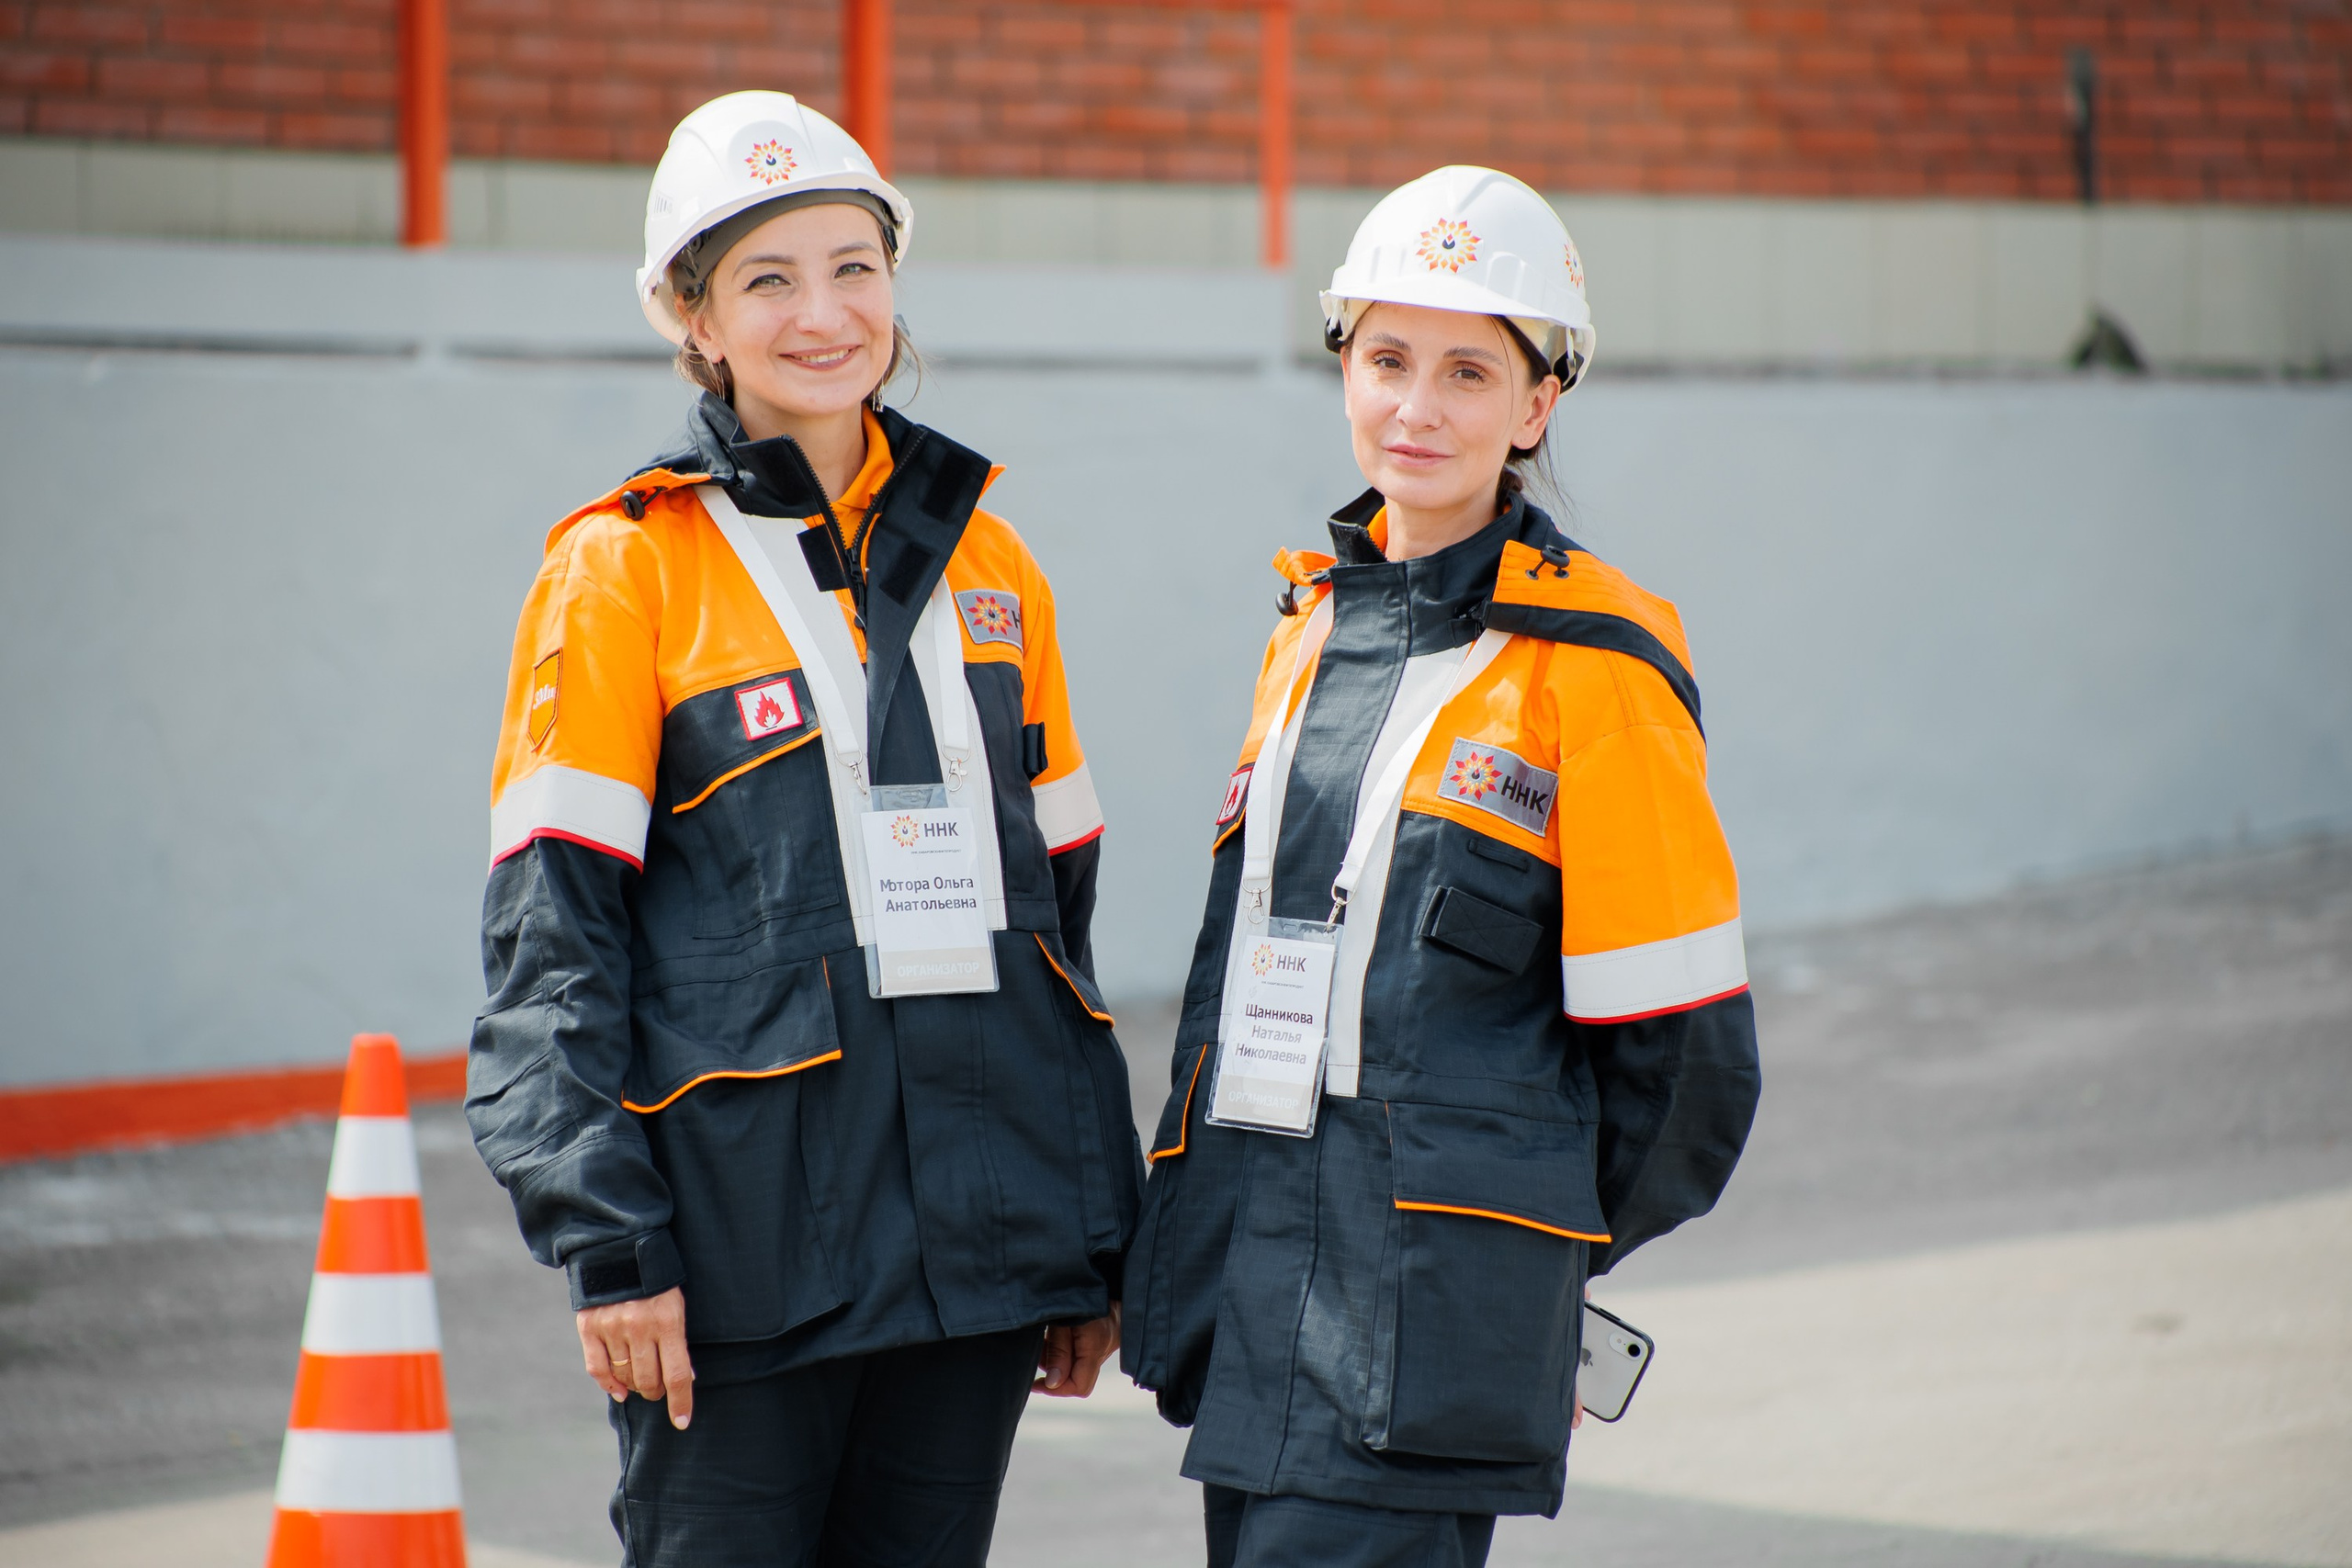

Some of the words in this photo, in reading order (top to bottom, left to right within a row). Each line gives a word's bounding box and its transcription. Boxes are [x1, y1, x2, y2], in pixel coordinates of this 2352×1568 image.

[1501, 775, 1549, 815] ННК
[923, 821, 959, 837] ННК
[880, 878, 930, 894] Мотора
[933, 876, 974, 890] Ольга
[886, 897, 978, 913] Анатольевна
[897, 961, 980, 978] ОРГАНИЗАТОР
[1276, 954, 1307, 973] ННК
[1245, 1003, 1314, 1024] Щанникова
[1251, 1025, 1302, 1043] Наталья
[1235, 1043, 1306, 1065] Николаевна
[1228, 1090, 1299, 1110] ОРГАНИЗАТОР
